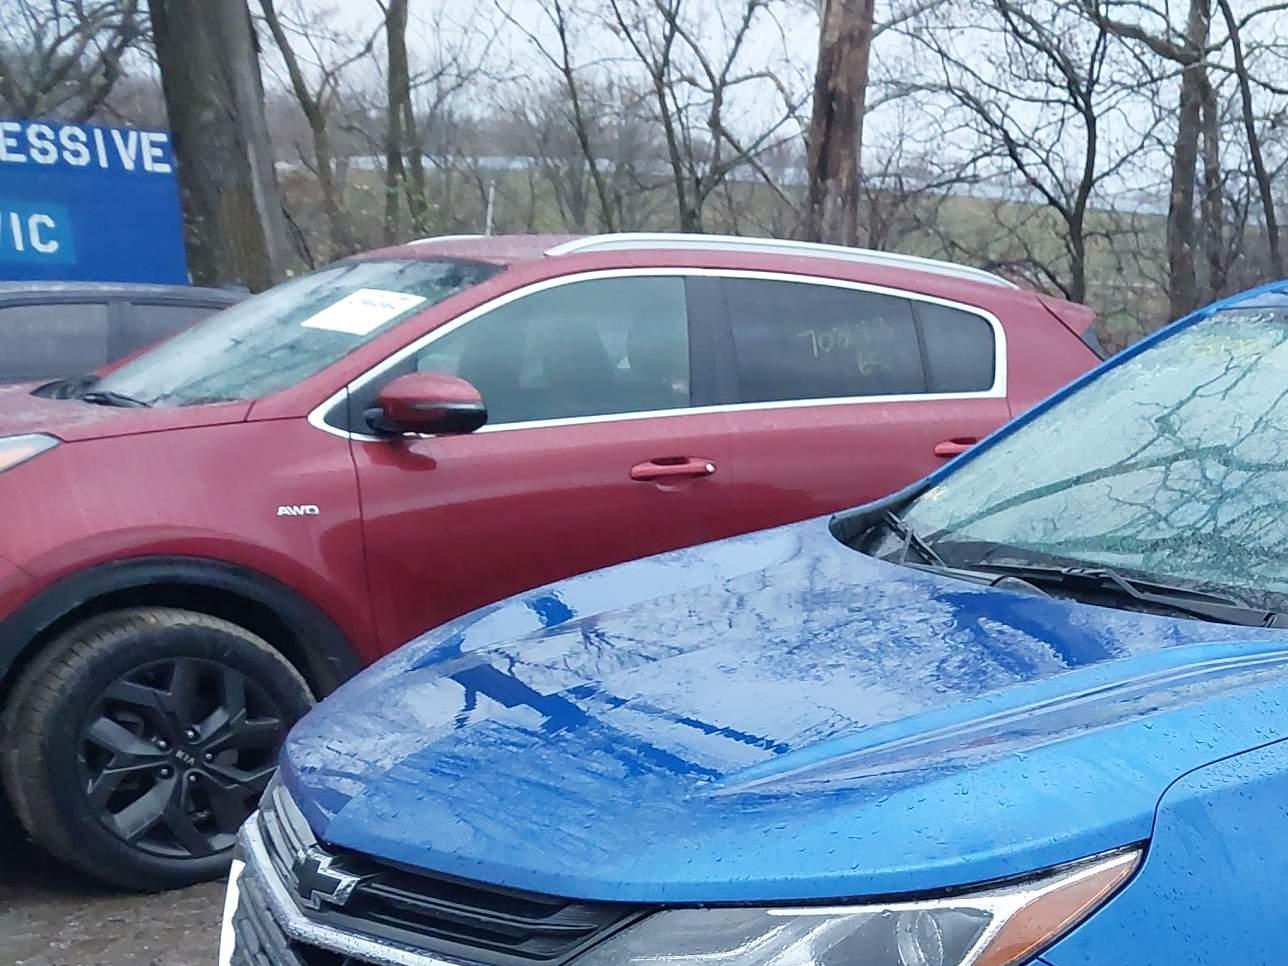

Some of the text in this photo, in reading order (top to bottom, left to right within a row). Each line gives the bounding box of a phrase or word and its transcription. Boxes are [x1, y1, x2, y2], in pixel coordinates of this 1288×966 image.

[0, 121, 172, 173] ESSIVE
[0, 211, 60, 254] IC
[276, 503, 321, 517] AWD
[175, 749, 196, 766] KIA
